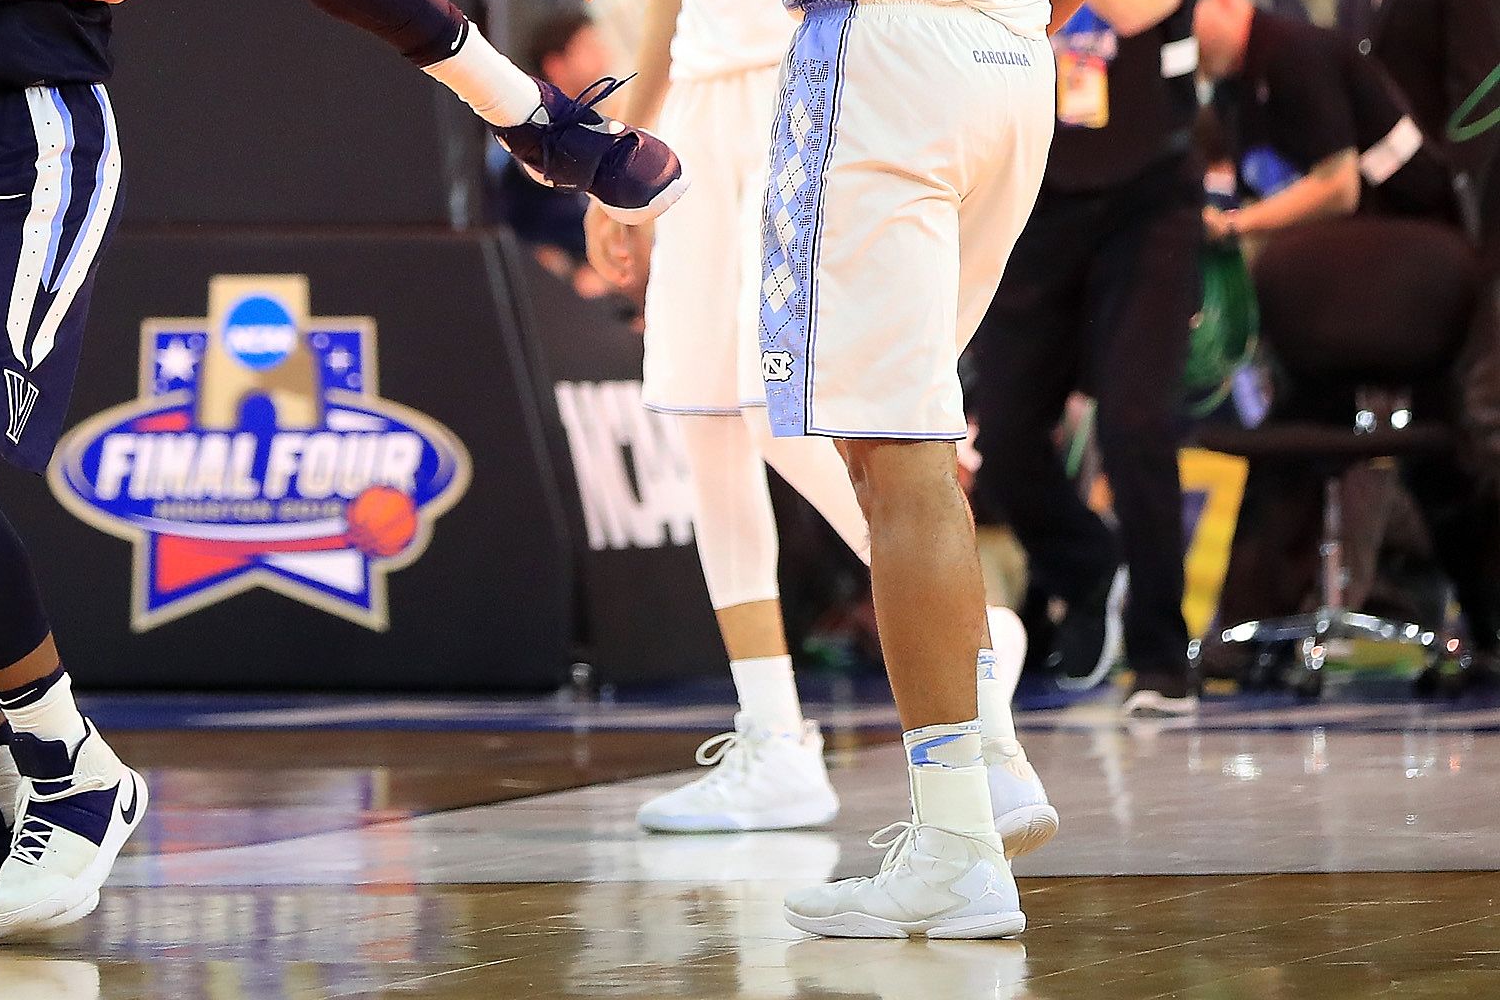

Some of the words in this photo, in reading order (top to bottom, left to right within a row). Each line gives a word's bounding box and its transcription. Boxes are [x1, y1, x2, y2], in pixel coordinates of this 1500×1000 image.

[972, 49, 1032, 67] CAROLINA
[95, 432, 261, 501] FINAL
[262, 431, 424, 501] FOUR
[554, 379, 698, 551] NCA
